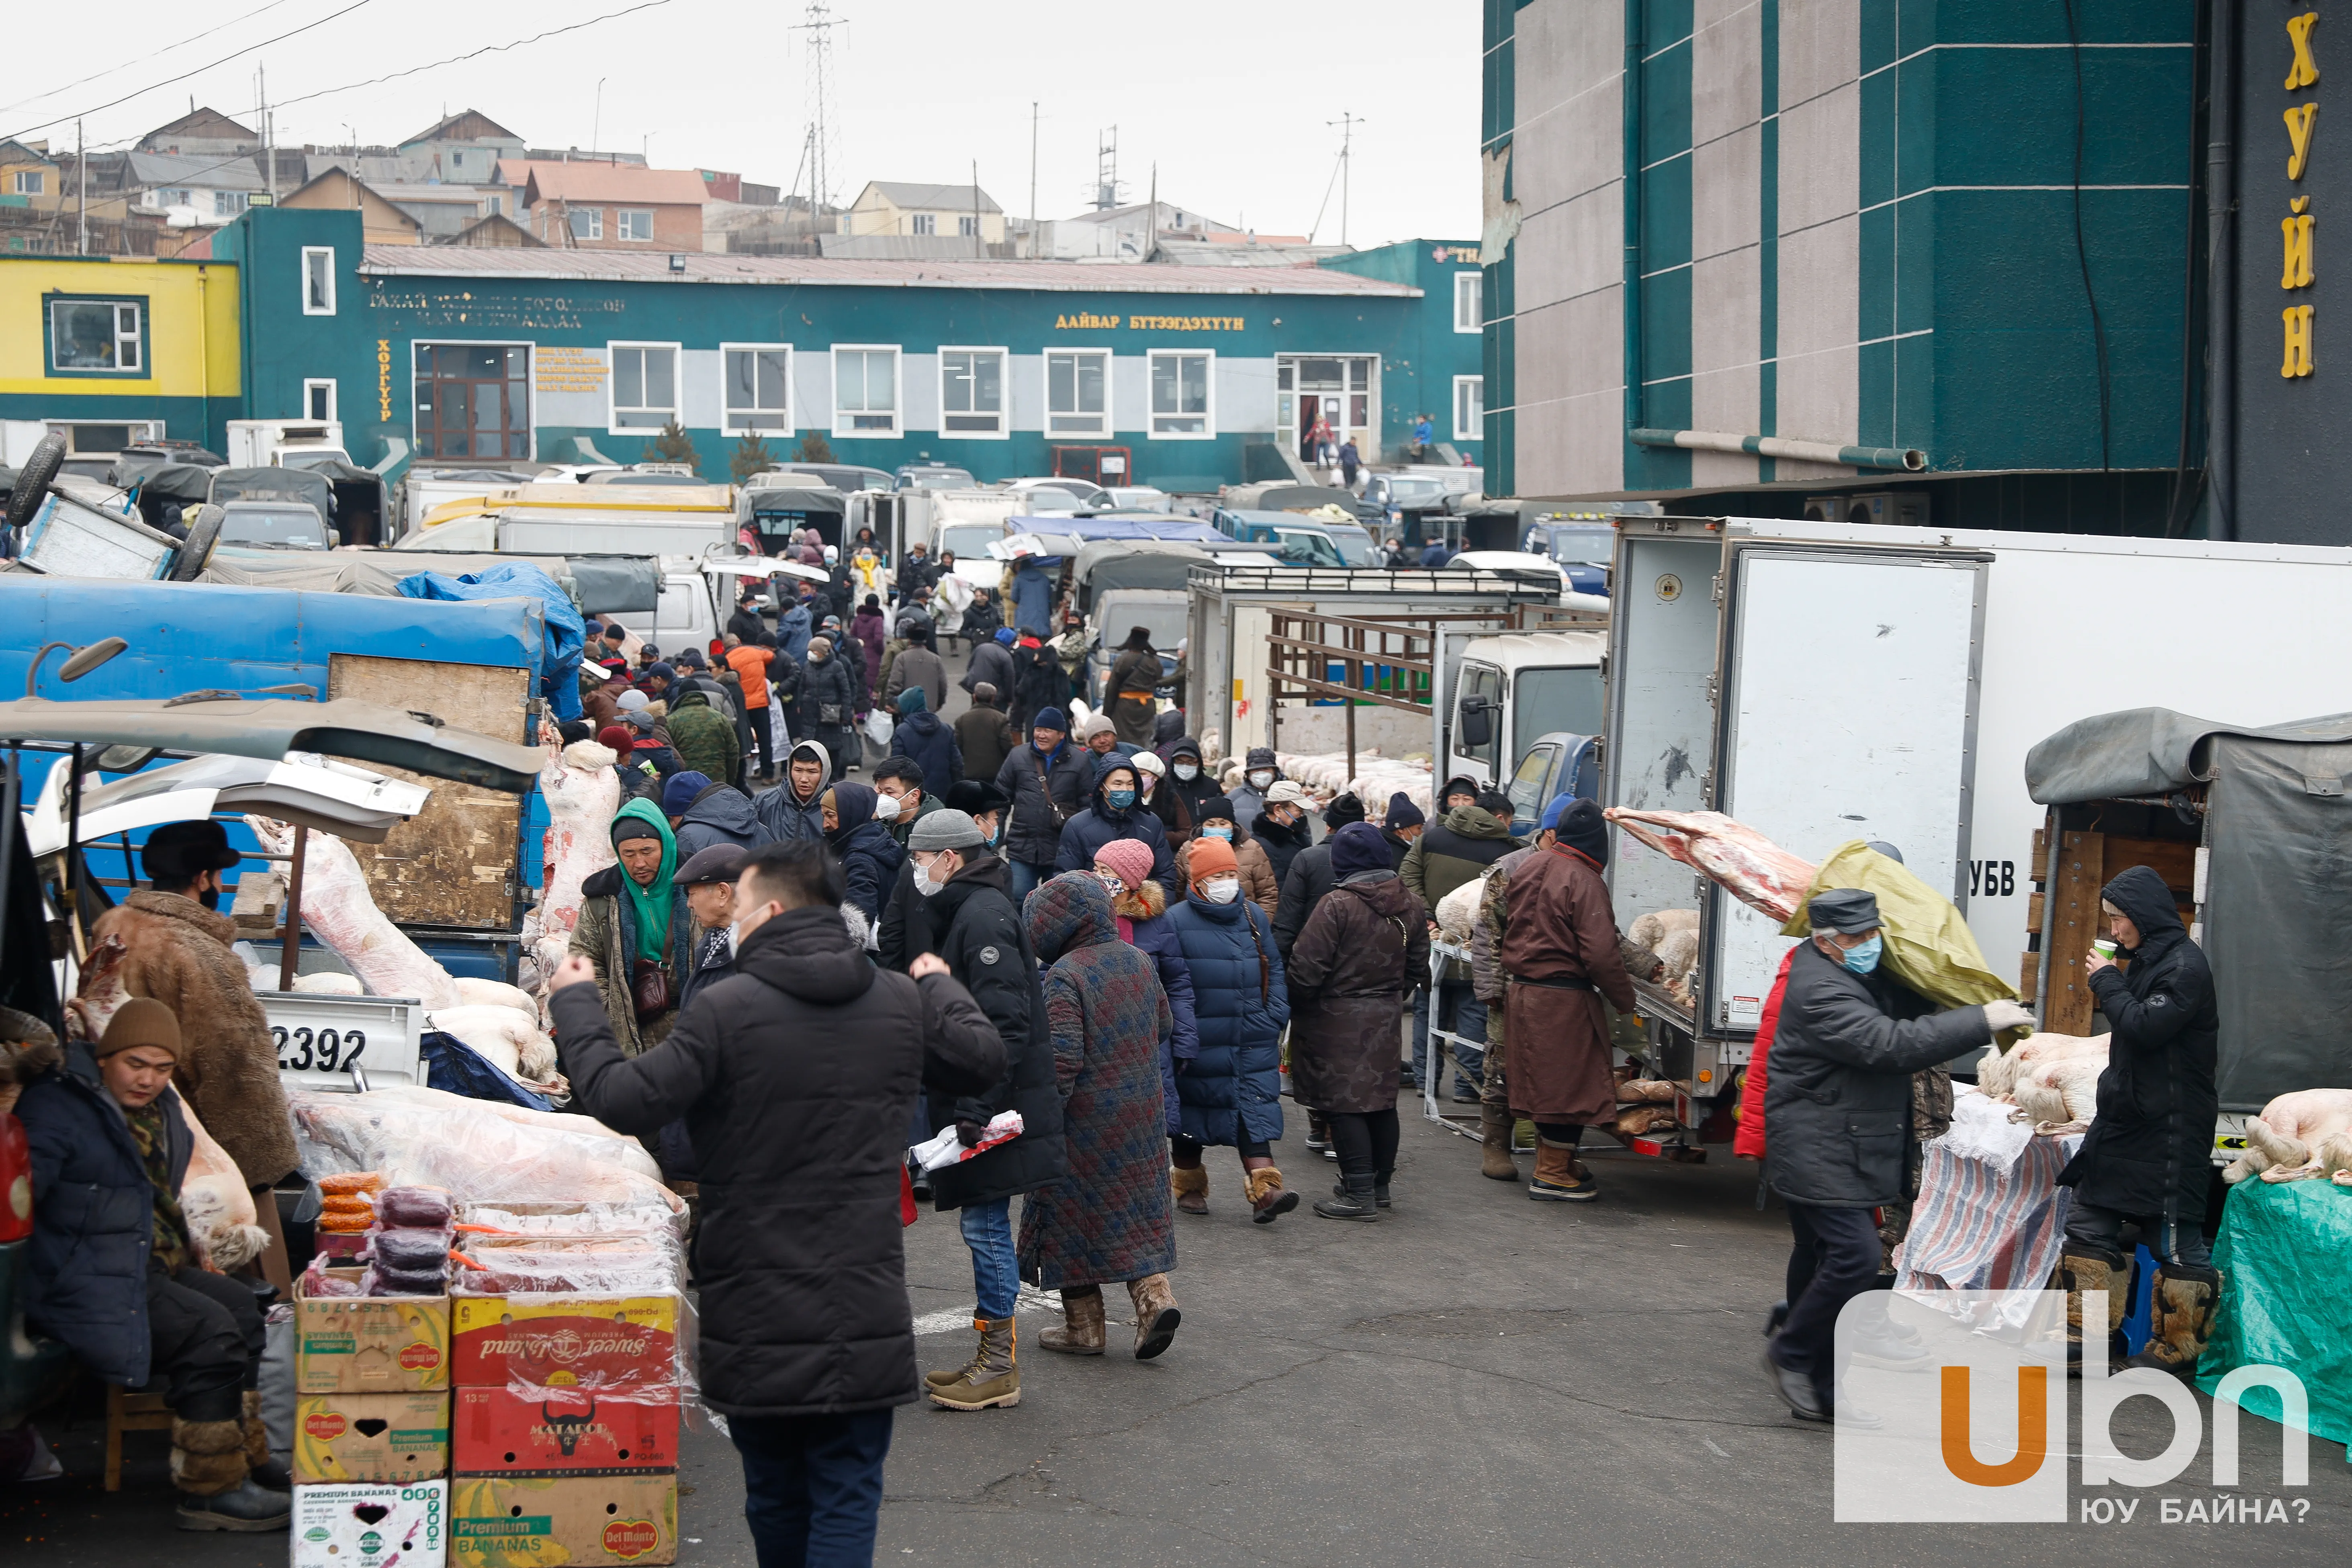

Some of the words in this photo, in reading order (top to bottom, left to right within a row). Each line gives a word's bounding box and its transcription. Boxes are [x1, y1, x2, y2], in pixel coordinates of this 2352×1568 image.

[1055, 311, 1120, 329] ДАЙВАР
[1129, 315, 1244, 331] БҮТЭЭГДЭХҮҮН
[1970, 861, 2014, 896] УБВ
[271, 1026, 366, 1073] 2392
[461, 1306, 470, 1323] 5
[480, 1339, 550, 1359] Island
[587, 1339, 646, 1357] Sweet
[464, 1394, 477, 1402] 13
[393, 1434, 433, 1442] Premium
[393, 1444, 438, 1453] BANANAS
[304, 1490, 348, 1499] PREMIUM
[351, 1488, 397, 1497] BANANAS
[459, 1521, 530, 1534] Premium
[426, 1540, 439, 1548] 10
[606, 1531, 622, 1543] Del
[624, 1531, 655, 1543] Monte
[459, 1538, 541, 1553] BANANAS
